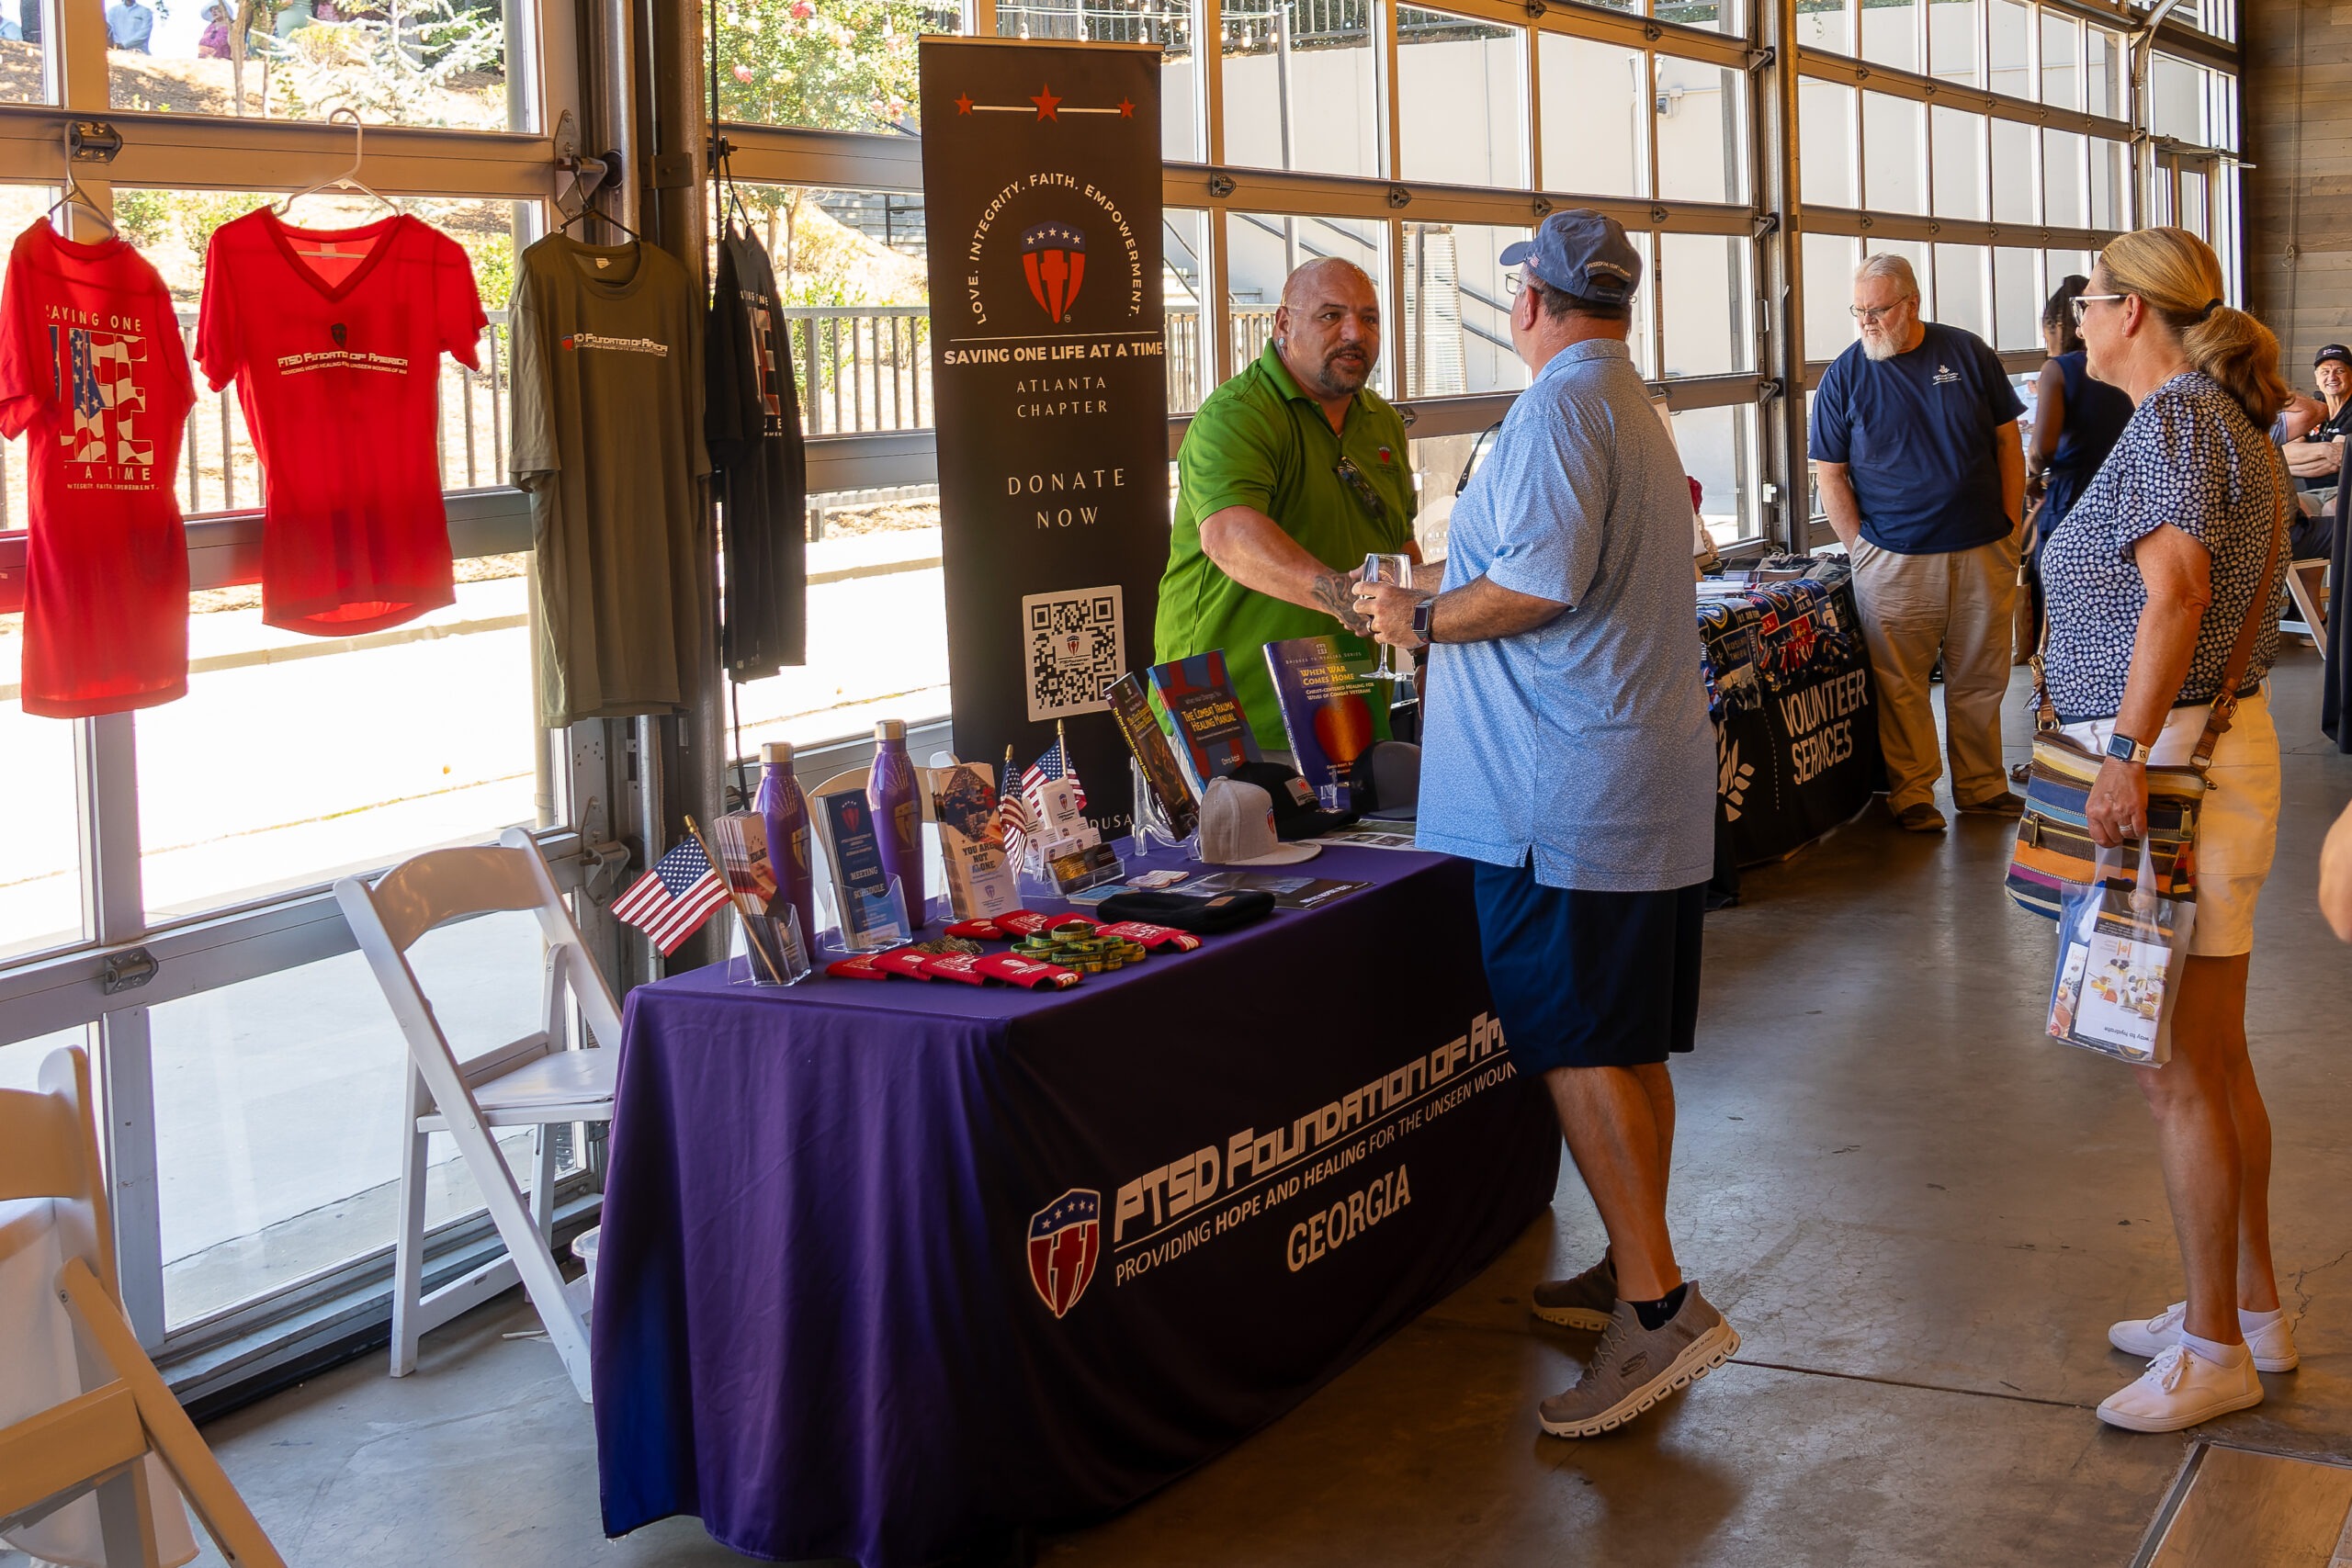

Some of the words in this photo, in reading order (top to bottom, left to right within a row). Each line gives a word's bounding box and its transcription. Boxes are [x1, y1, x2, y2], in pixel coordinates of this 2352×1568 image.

[1029, 173, 1079, 190] FAITH.
[968, 181, 1025, 262] INTEGRITY.
[1084, 184, 1142, 317] EMPOWERMENT.
[967, 269, 988, 325] LOVE.
[46, 305, 100, 325] AVING
[110, 315, 141, 333] ONE
[944, 348, 1010, 365] SAVING
[1013, 346, 1047, 361] ONE
[1051, 344, 1085, 360] LIFE
[1090, 344, 1112, 358] AT
[1115, 343, 1128, 356] A
[1131, 341, 1163, 356] TIME
[1016, 376, 1106, 394] ATLANTA
[1016, 400, 1108, 418] CHAPTER
[85, 465, 93, 479] A
[1007, 468, 1125, 496] DONATE
[1036, 506, 1098, 530] NOW
[1300, 667, 1326, 677] WHEN
[1327, 665, 1347, 674] WAR
[1303, 676, 1329, 686] COMES
[1331, 673, 1355, 682] HOME
[1779, 668, 1869, 739] VOLUNTEER
[1792, 718, 1853, 785] SERVICES
[962, 846, 978, 856] YOU
[979, 841, 995, 852] ARE
[972, 852, 989, 863] NOT
[850, 865, 878, 881] MEETING
[1114, 1144, 1221, 1244] PTSD
[1430, 1034, 1468, 1087] OF
[1115, 1225, 1211, 1286] PROVIDING
[1215, 1195, 1261, 1235] HOPE
[1264, 1176, 1300, 1211] AND
[1303, 1140, 1366, 1190] HEALING
[1369, 1124, 1396, 1155] FOR
[1397, 1110, 1422, 1138] THE
[1425, 1080, 1472, 1122] UNSEEN
[1286, 1163, 1411, 1273] GEORGIA
